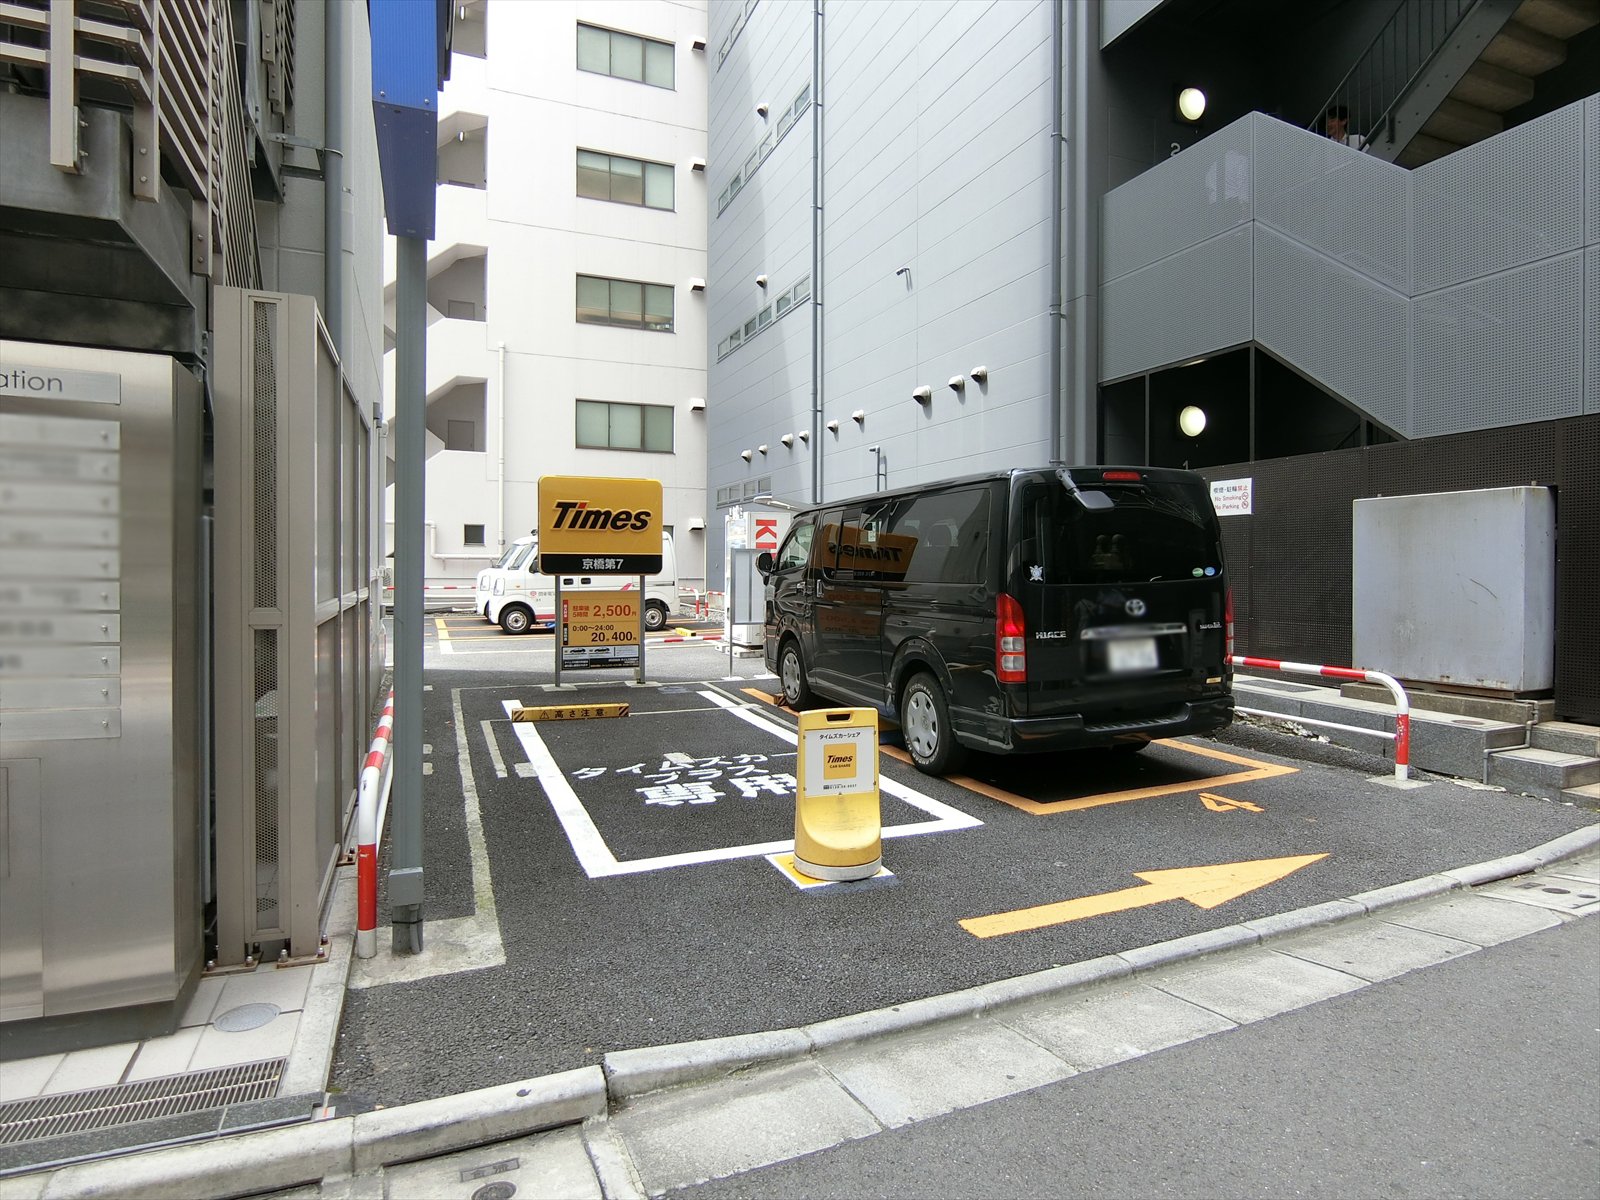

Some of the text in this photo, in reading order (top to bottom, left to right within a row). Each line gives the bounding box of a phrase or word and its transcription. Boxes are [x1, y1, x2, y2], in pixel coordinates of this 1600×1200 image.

[1170, 142, 1181, 157] 2
[0, 370, 63, 393] ation
[552, 501, 652, 531] Times
[581, 558, 623, 570] 京橋第7
[1035, 630, 1067, 639] HIACE
[554, 707, 606, 719] 高さ注意
[819, 731, 861, 740] タイムズカーシェア
[827, 754, 853, 764] Times
[1197, 792, 1265, 813] 4
